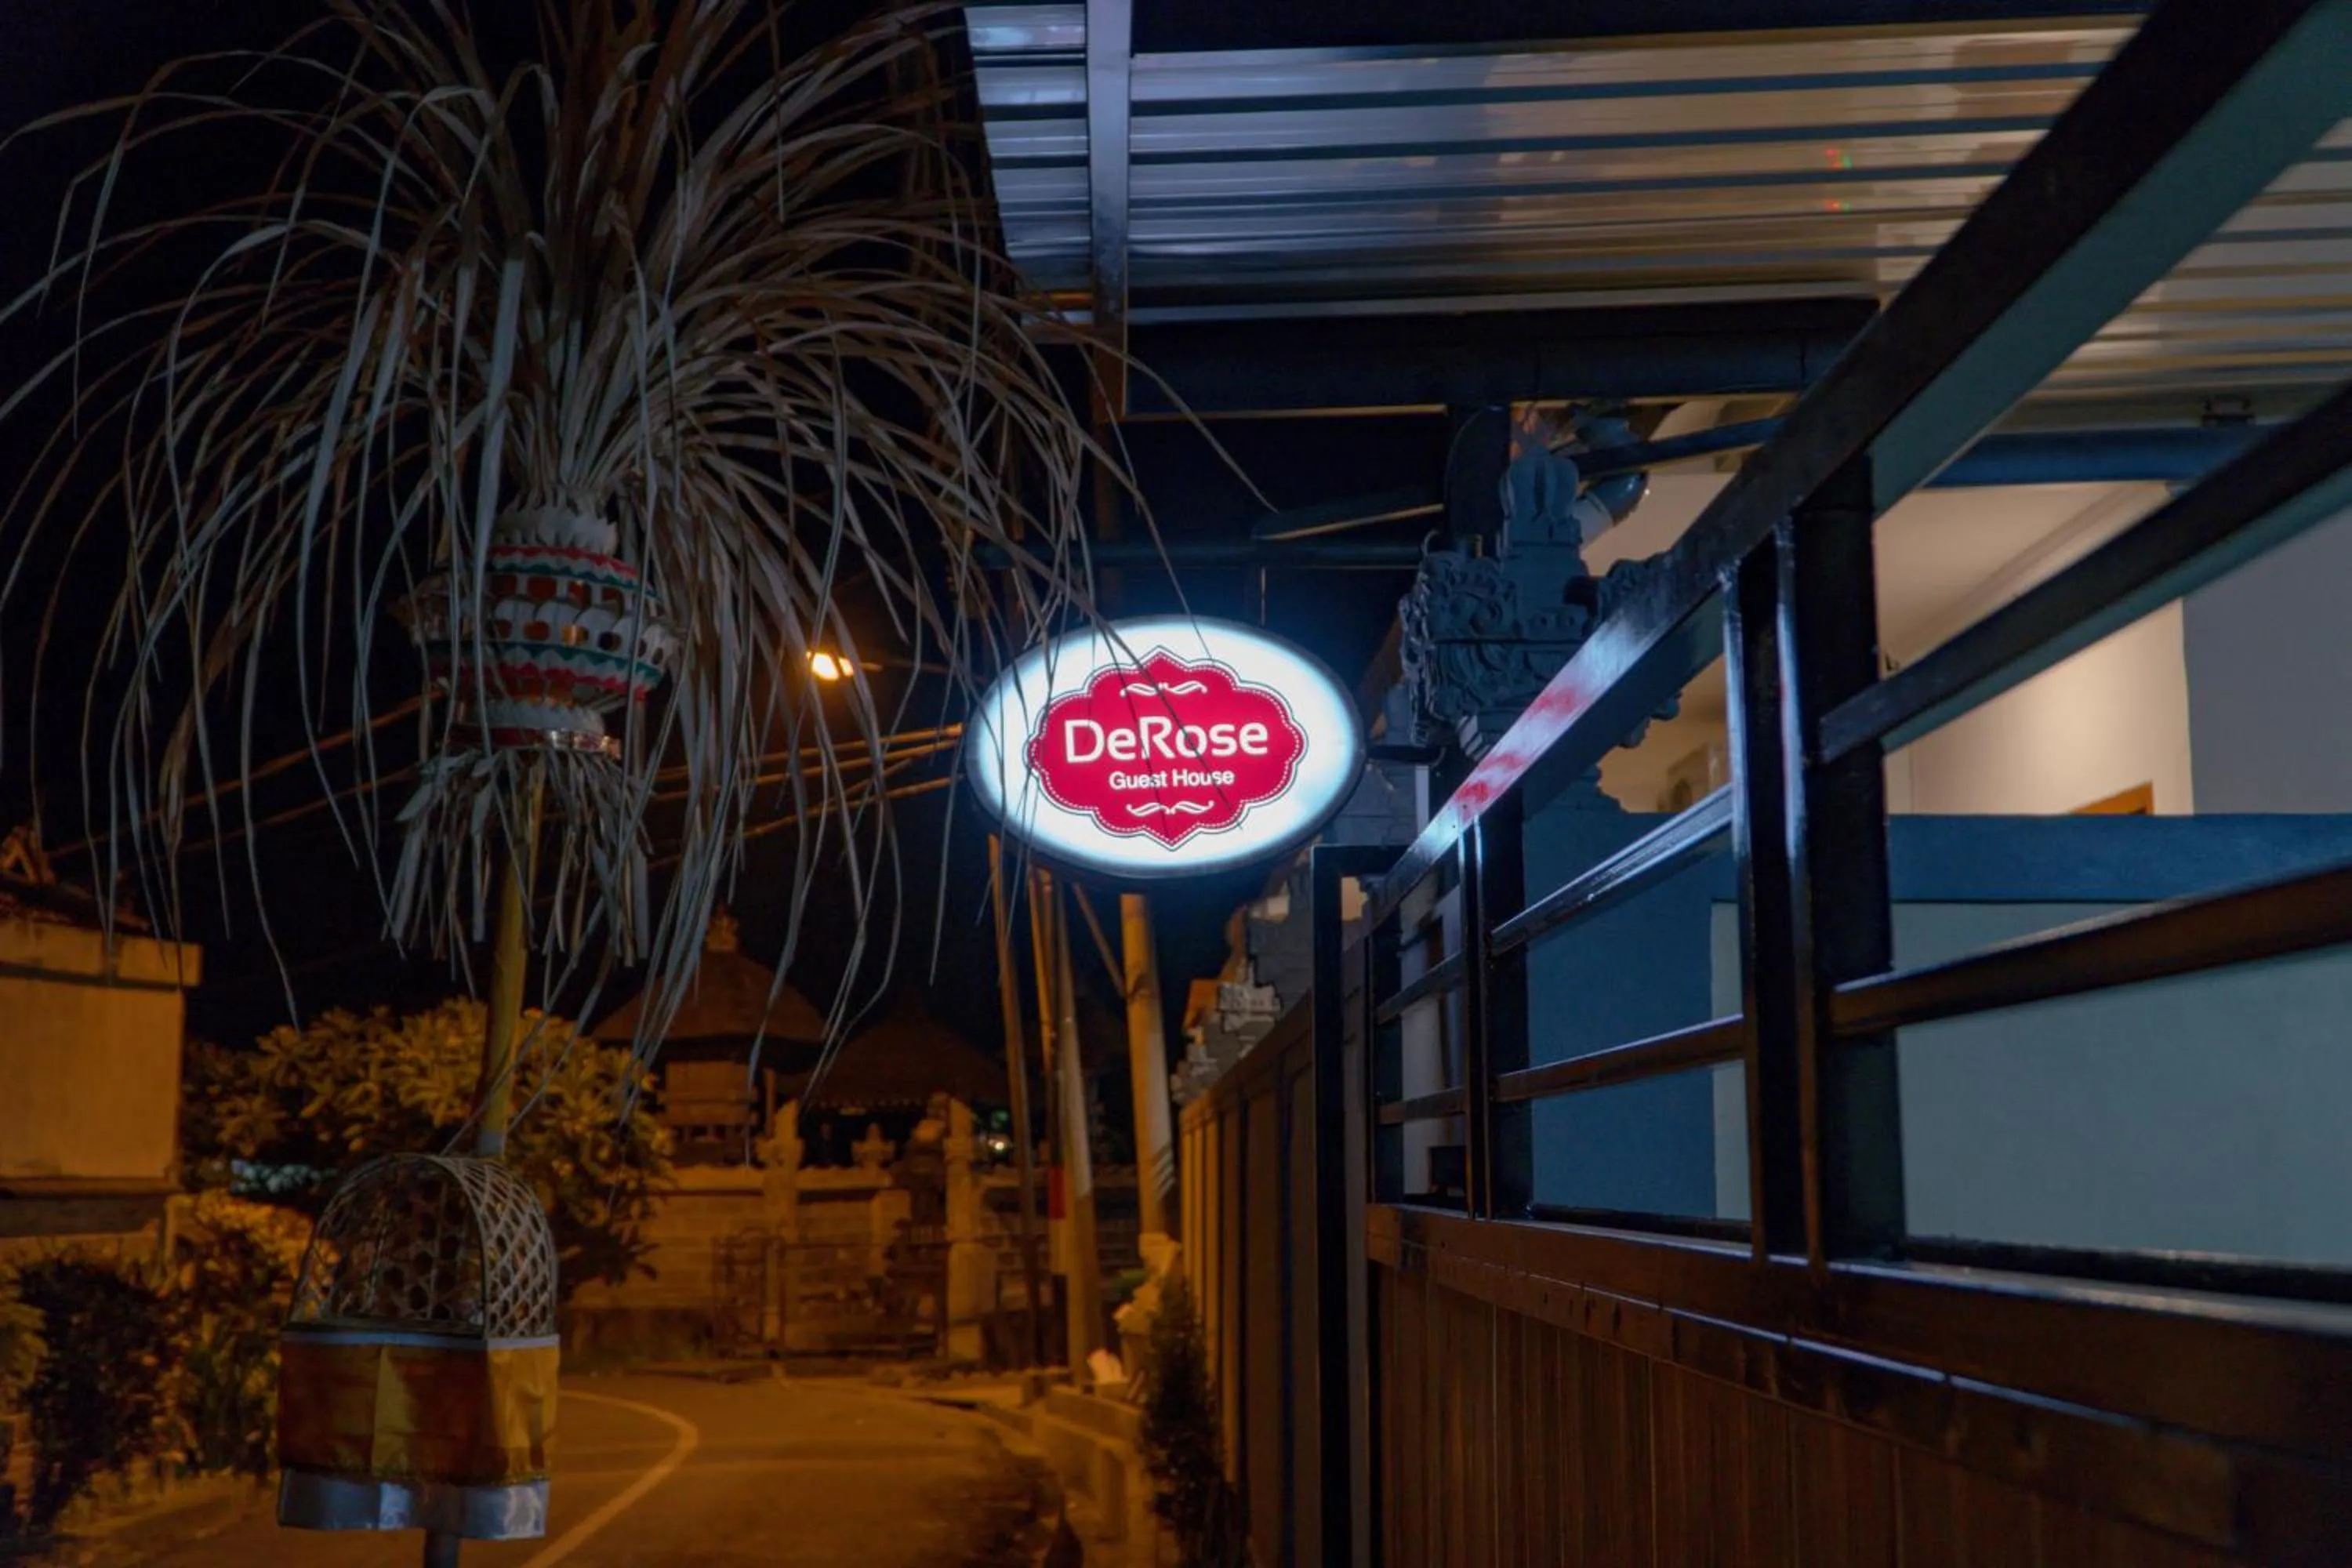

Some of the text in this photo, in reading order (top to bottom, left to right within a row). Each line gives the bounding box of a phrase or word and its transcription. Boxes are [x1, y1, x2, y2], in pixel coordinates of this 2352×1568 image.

[1064, 716, 1269, 764] DeRose
[1109, 768, 1235, 790] Guest House
